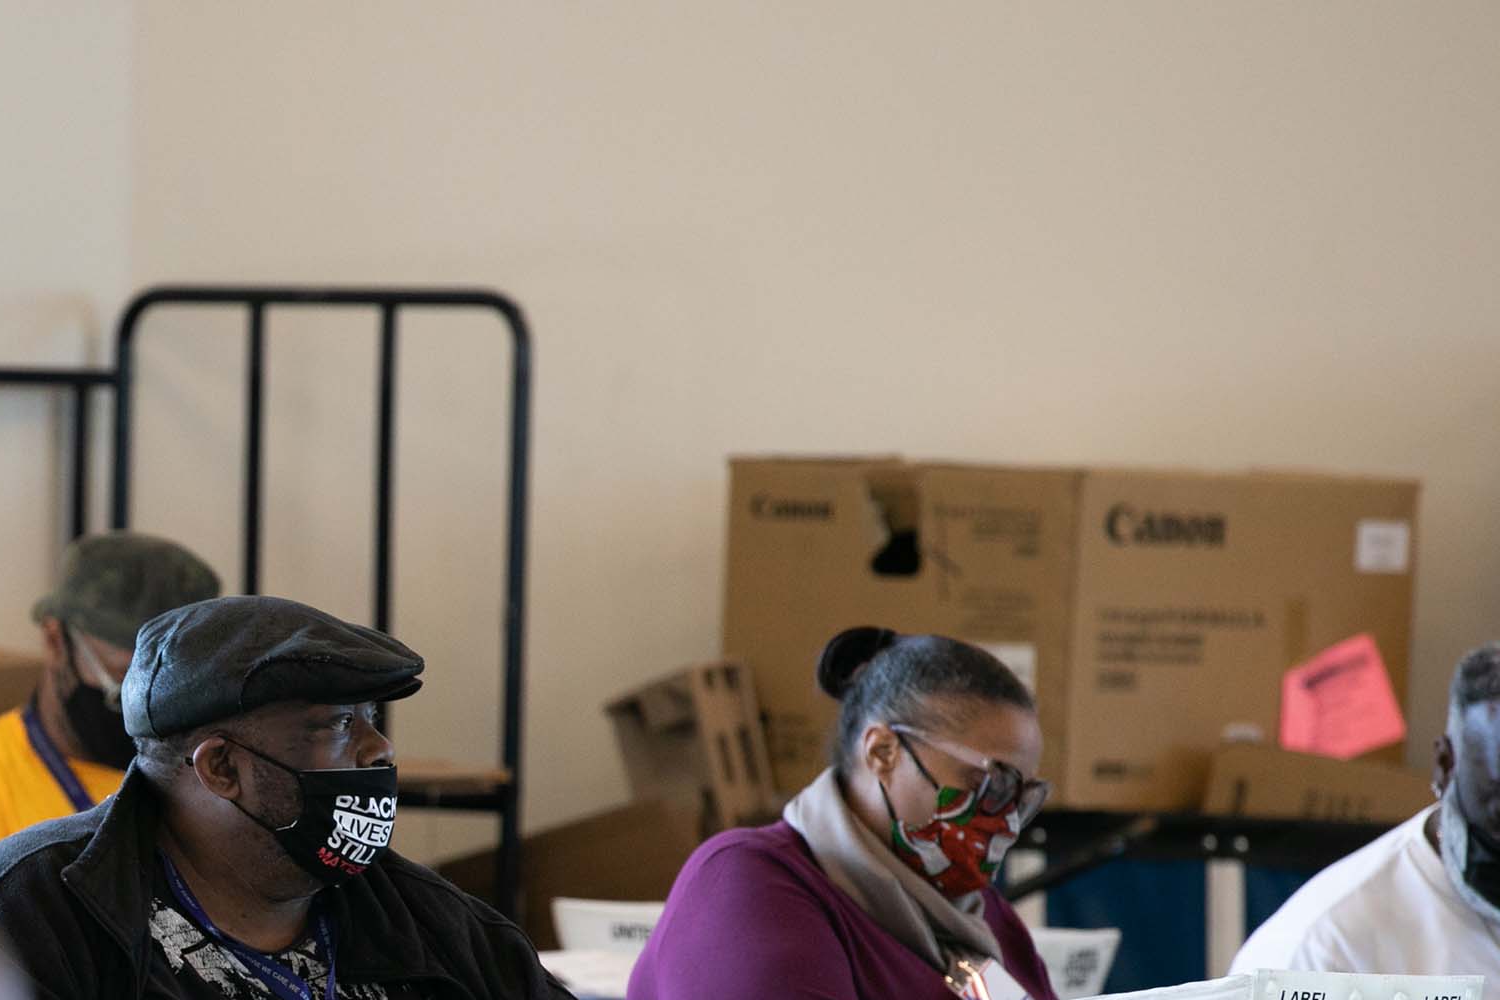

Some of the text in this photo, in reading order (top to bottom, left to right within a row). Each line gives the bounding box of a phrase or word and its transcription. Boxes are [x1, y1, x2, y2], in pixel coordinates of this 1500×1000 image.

[1103, 502, 1227, 547] Canon
[327, 827, 376, 865] STILL
[337, 814, 391, 843] LIVES
